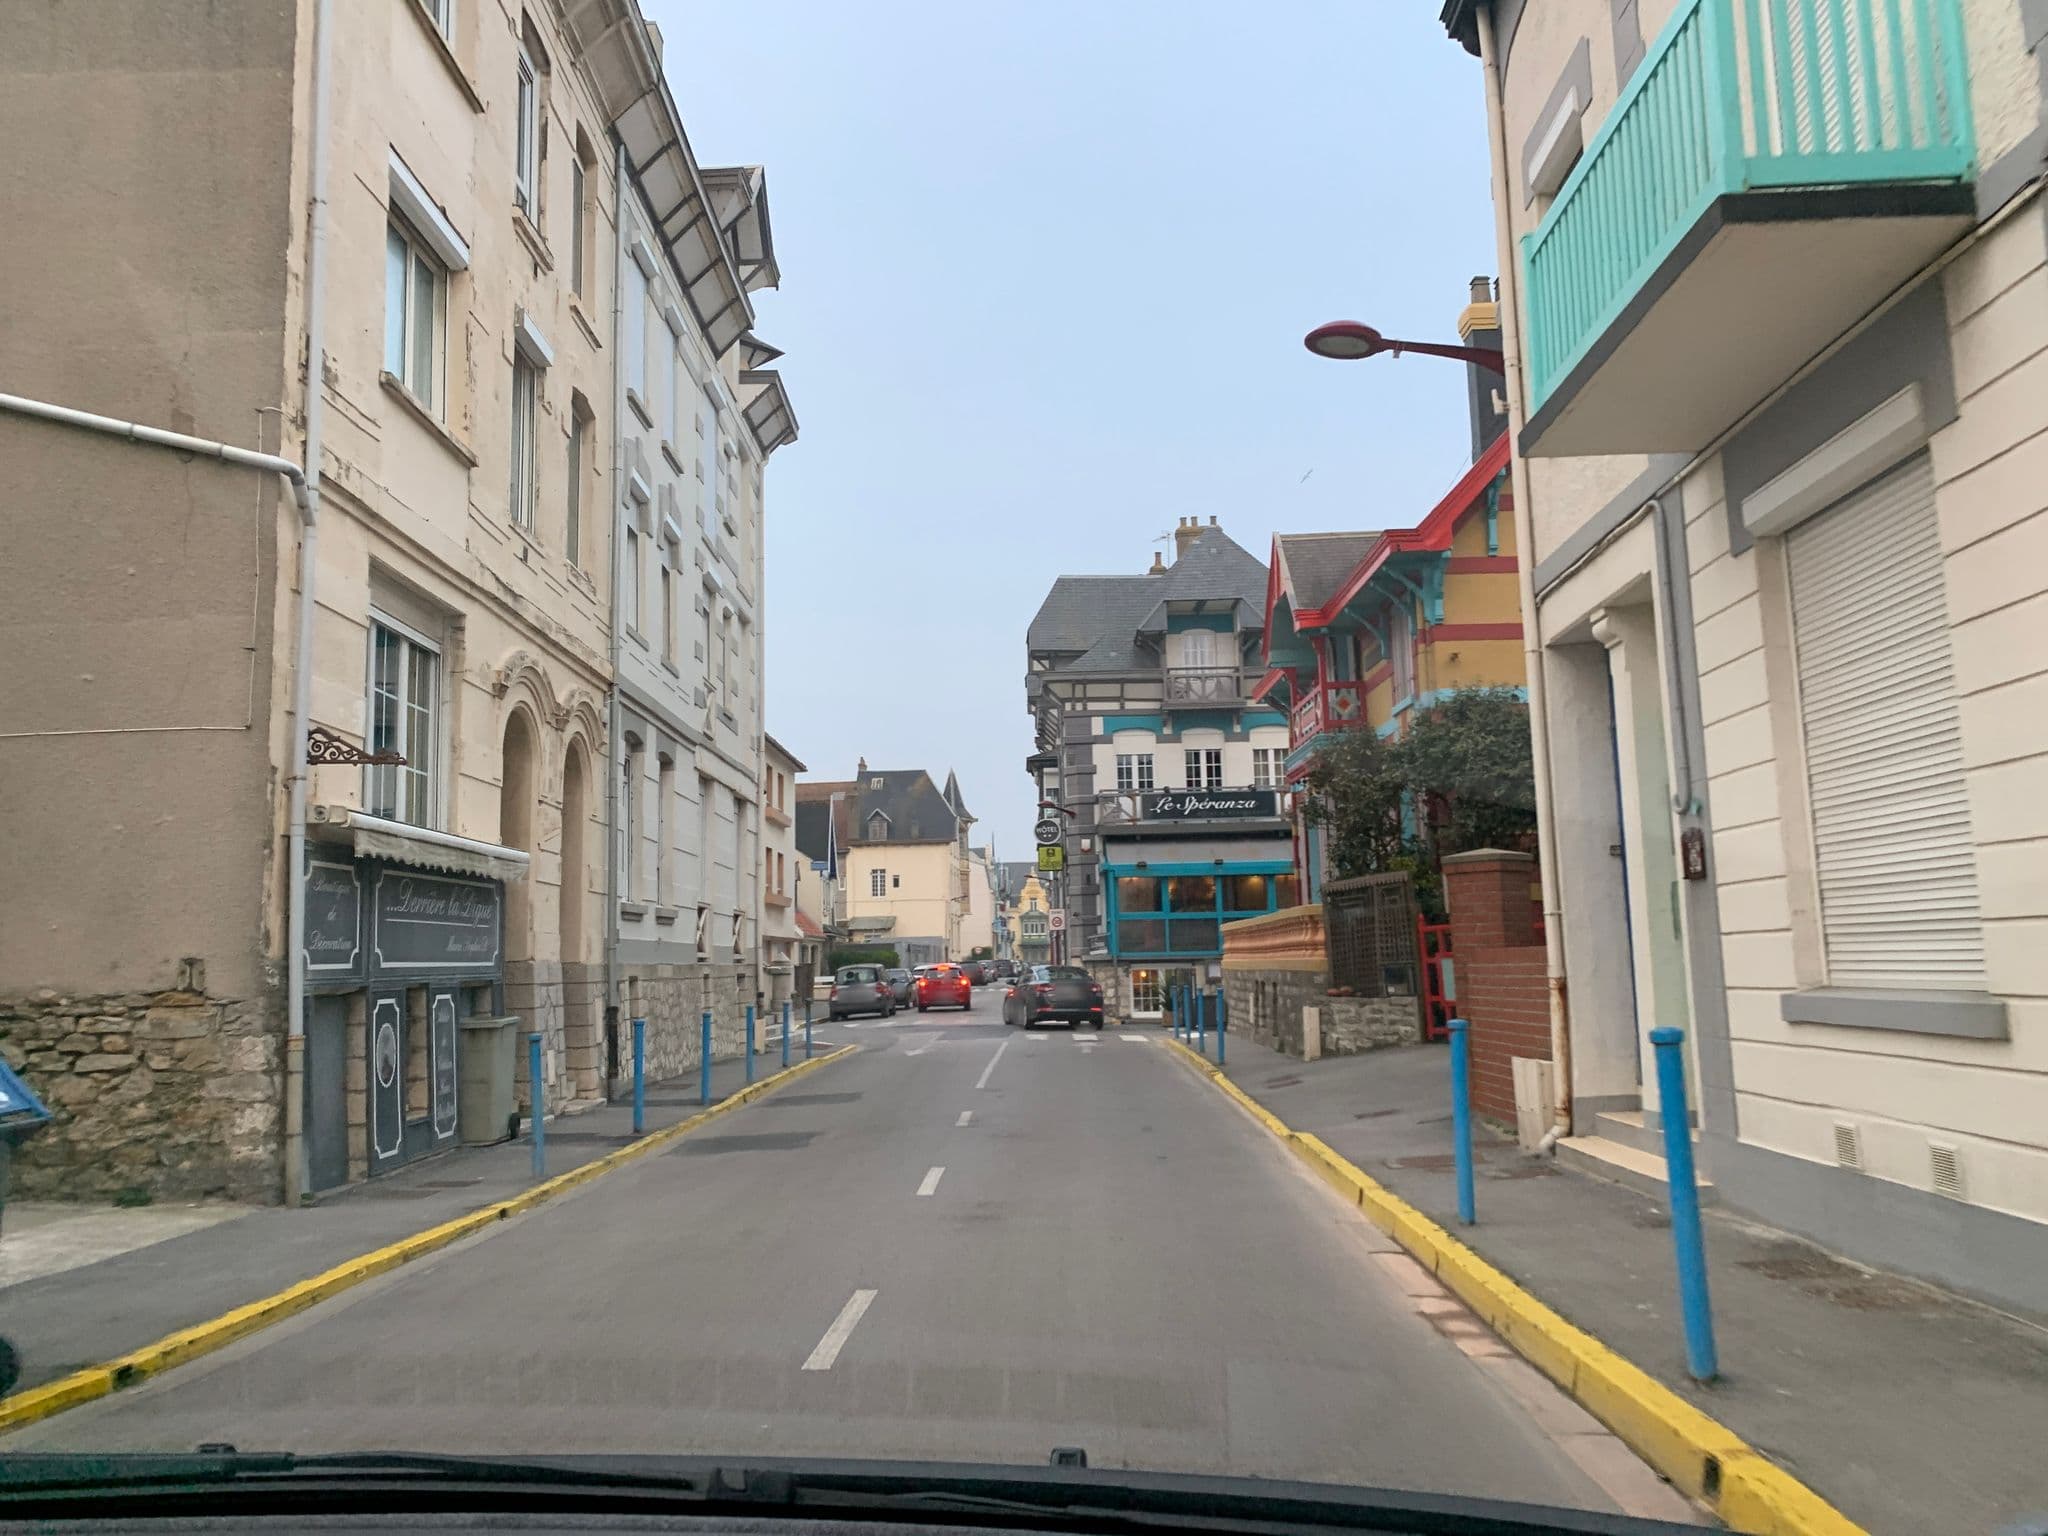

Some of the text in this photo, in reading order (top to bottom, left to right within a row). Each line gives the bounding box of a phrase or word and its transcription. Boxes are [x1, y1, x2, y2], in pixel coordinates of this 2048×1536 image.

[1149, 796, 1174, 813] Le
[1177, 795, 1257, 815] Spéranza
[1036, 824, 1058, 834] HÔTEL
